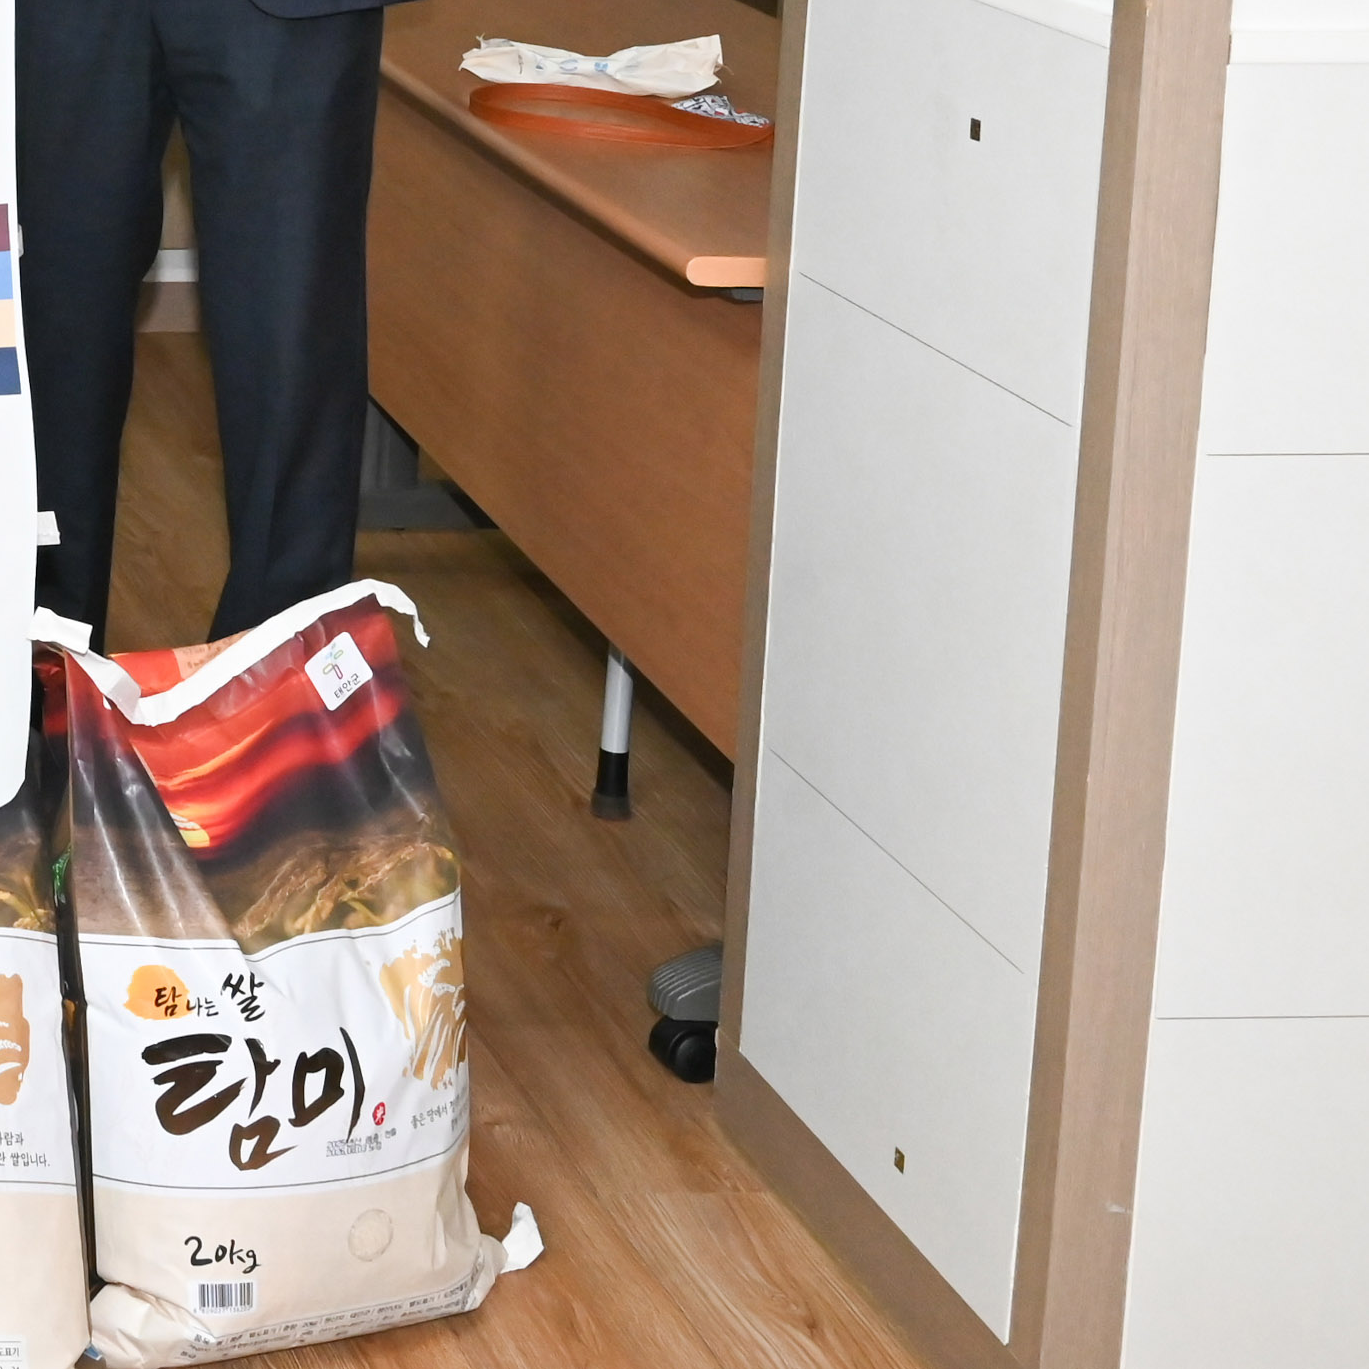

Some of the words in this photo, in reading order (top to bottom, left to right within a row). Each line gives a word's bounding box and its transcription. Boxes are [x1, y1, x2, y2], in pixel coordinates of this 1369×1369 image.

[333, 672, 361, 699] 태안군
[220, 971, 265, 1022] 쌀
[141, 1026, 366, 1171] 탐미
[426, 1103, 448, 1122] 땅에서
[10, 1151, 51, 1168] 쌀입니다.
[184, 1235, 262, 1275] 20kg
